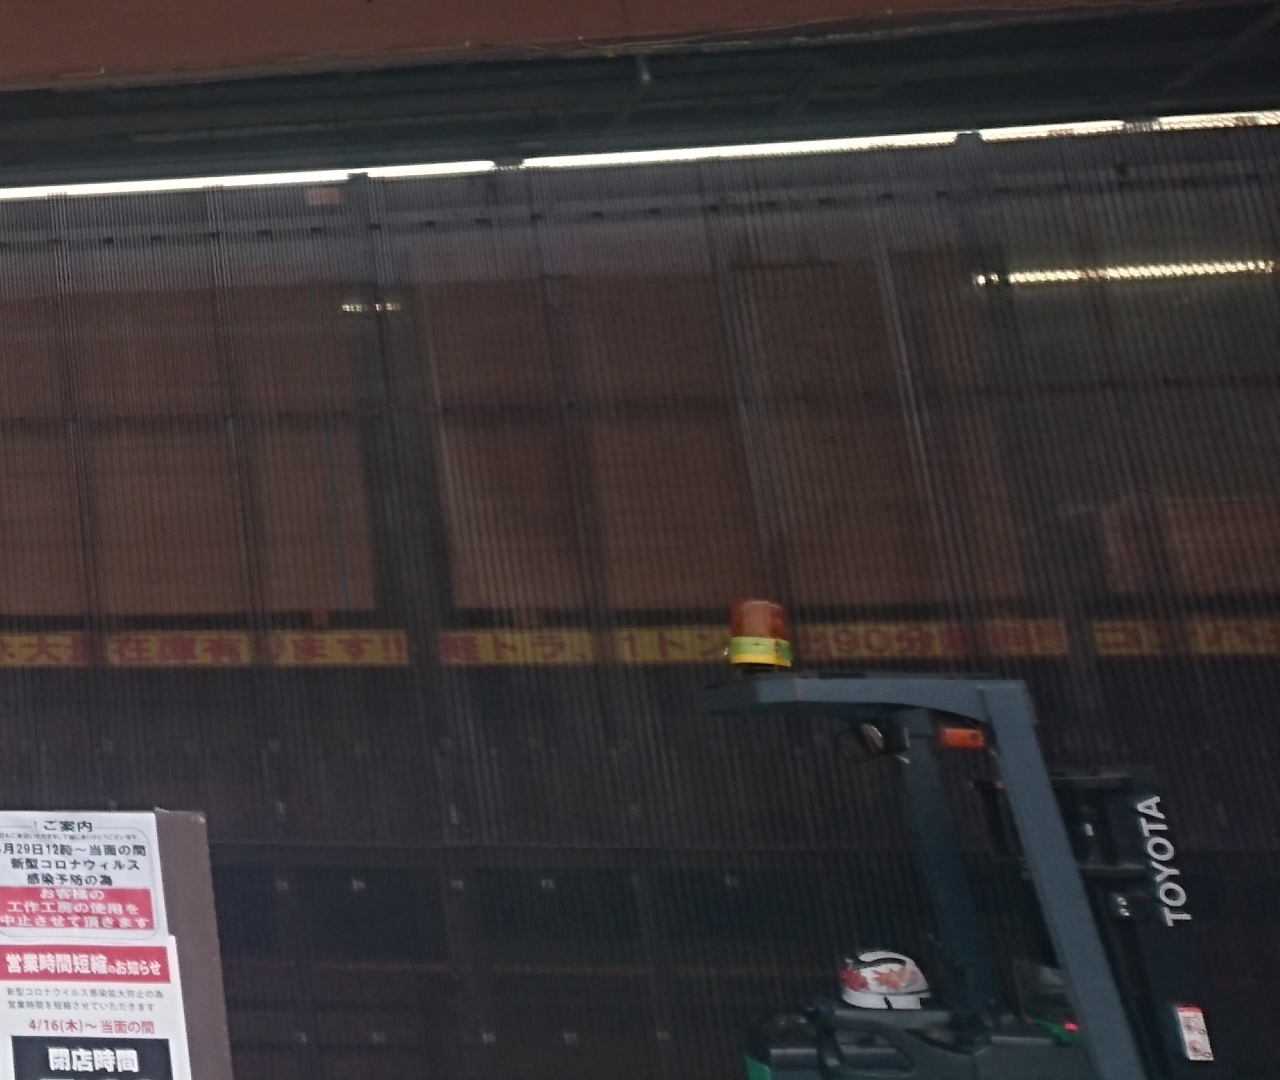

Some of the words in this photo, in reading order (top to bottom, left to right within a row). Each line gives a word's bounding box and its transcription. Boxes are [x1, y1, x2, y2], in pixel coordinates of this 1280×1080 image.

[43, 820, 93, 832] ご案内
[1136, 795, 1193, 928] TOYOTA
[27, 873, 113, 887] 感染予防の為
[40, 889, 105, 900] お客様の
[5, 953, 162, 976] 営業時間短縮のお知らせ
